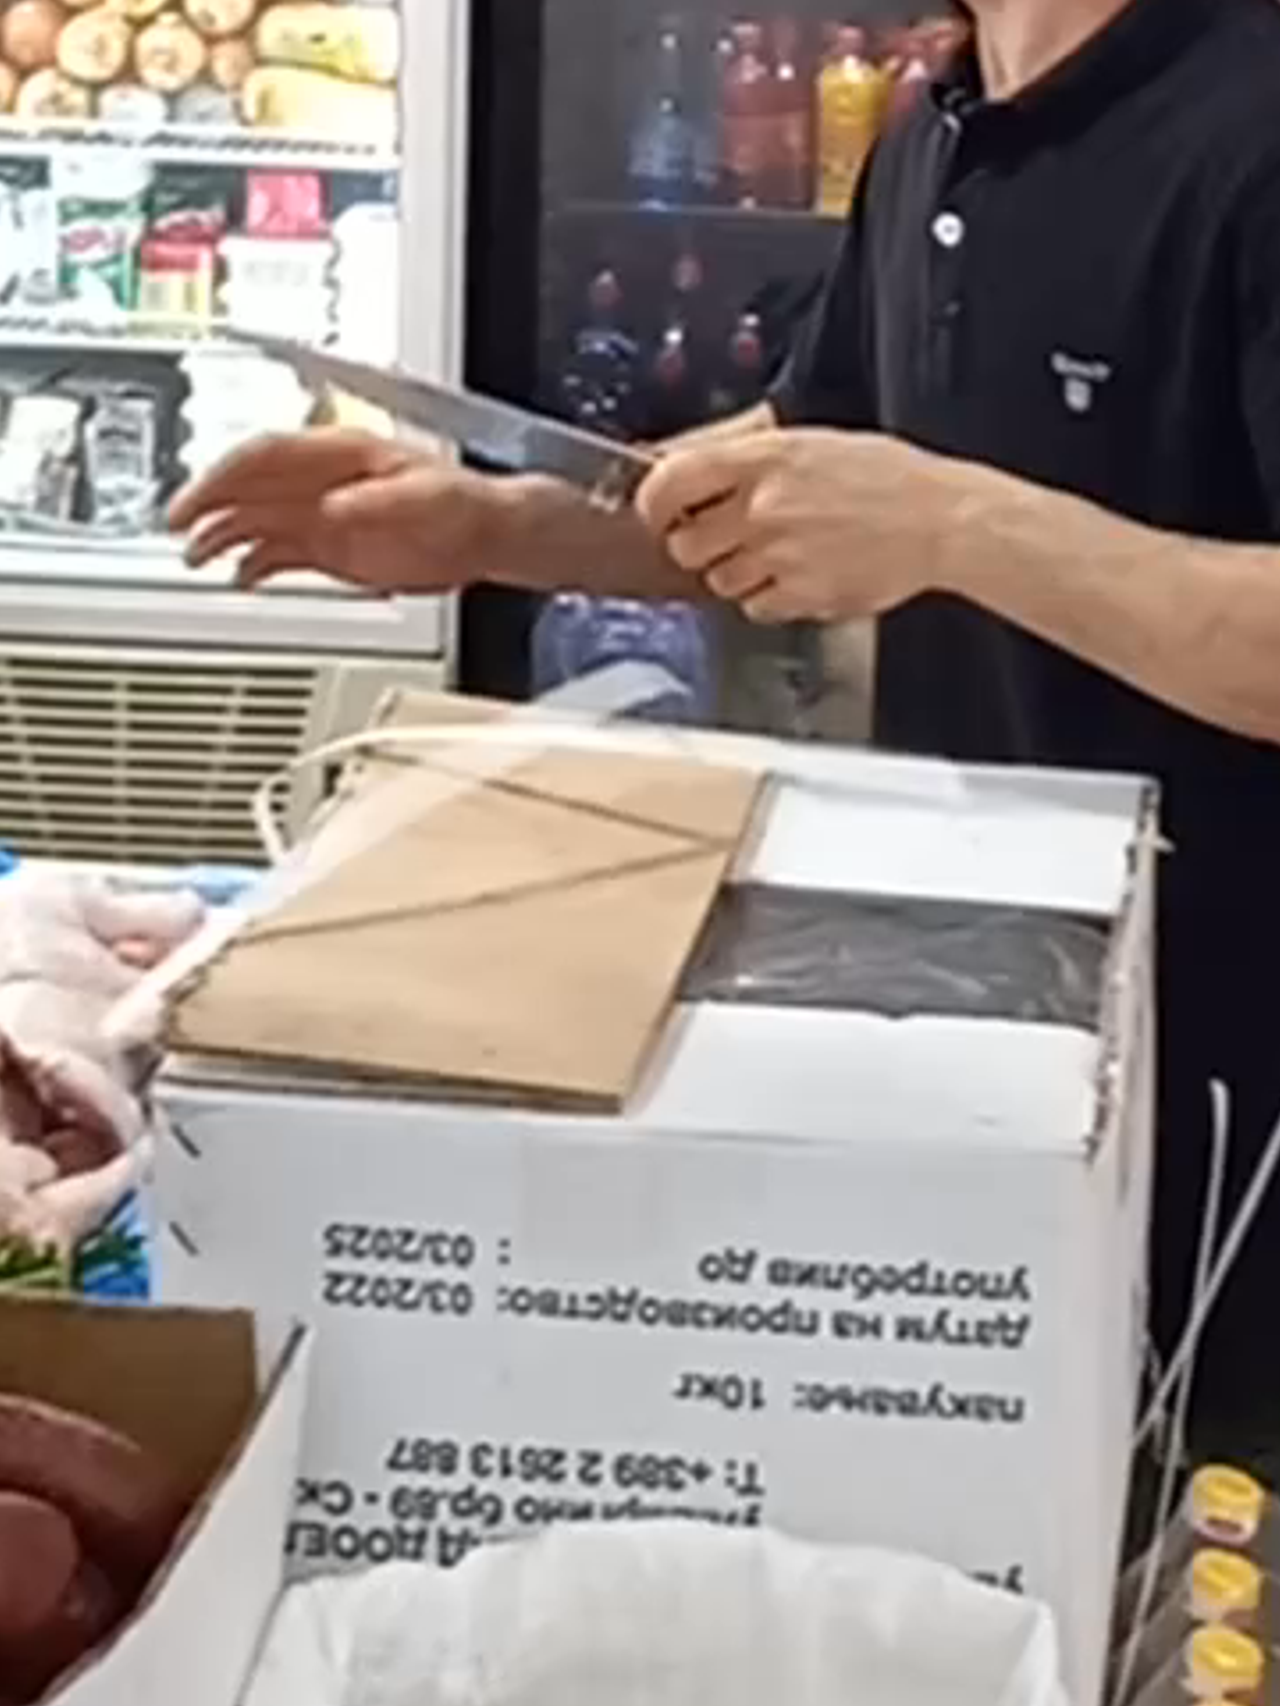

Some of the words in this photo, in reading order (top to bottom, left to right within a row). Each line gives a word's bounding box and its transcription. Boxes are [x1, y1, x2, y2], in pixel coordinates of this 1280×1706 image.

[322, 1222, 475, 1268] 03/2025
[698, 1247, 758, 1283] до
[767, 1256, 1030, 1301] употреблив
[322, 1271, 474, 1315] 03/2022
[831, 1311, 882, 1339] на
[895, 1309, 1030, 1349] датум
[672, 1371, 765, 1410] 10кг
[386, 1437, 460, 1475] 887
[468, 1441, 567, 1483] 2613
[577, 1451, 603, 1485] 2
[612, 1452, 713, 1491] +389
